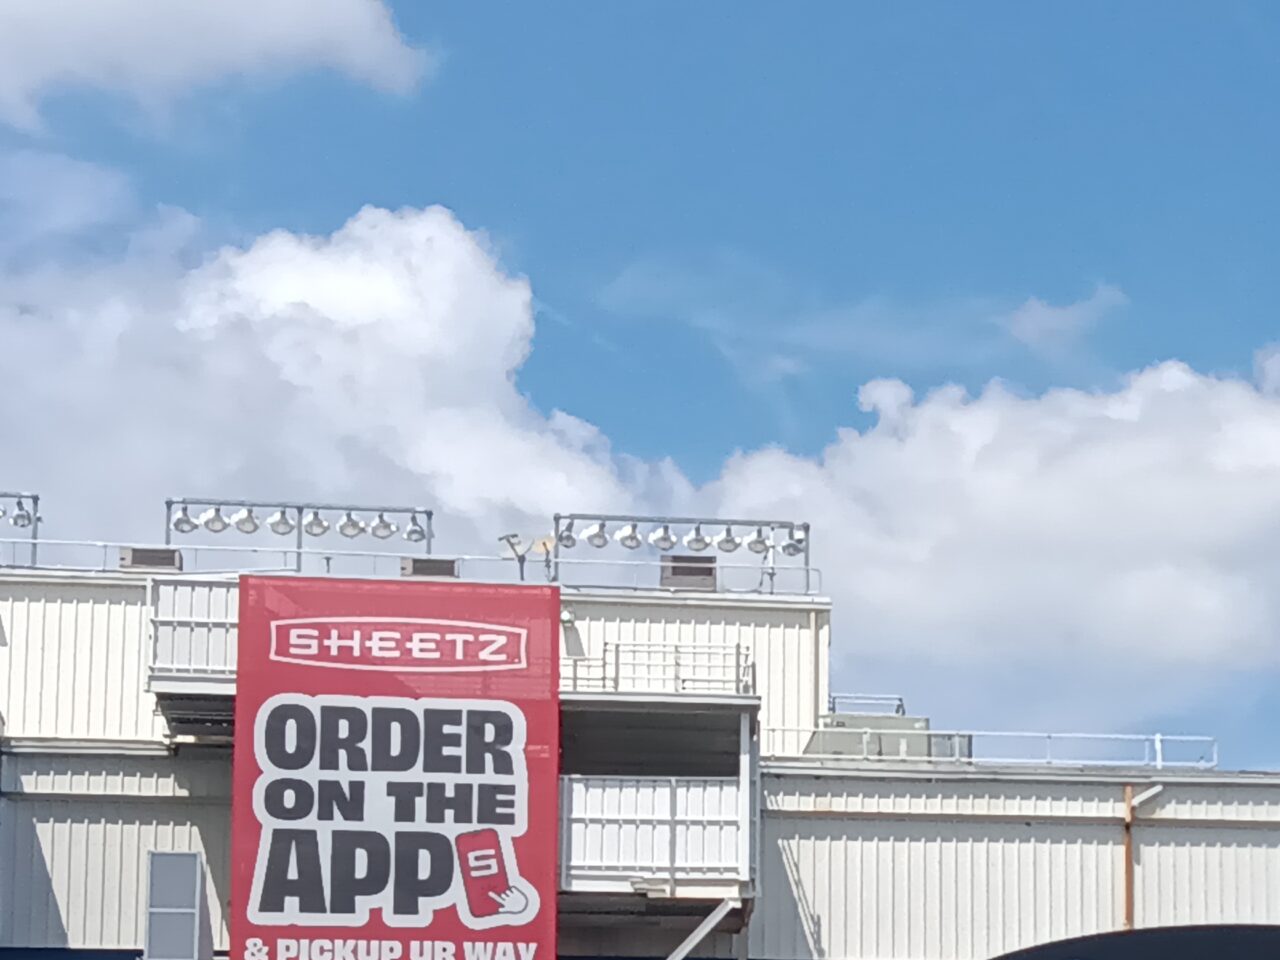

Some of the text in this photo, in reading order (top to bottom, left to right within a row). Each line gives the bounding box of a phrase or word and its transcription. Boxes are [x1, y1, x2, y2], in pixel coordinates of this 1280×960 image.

[289, 627, 508, 661] SHEETZ
[264, 703, 515, 775] ORDER
[263, 778, 516, 825] ON THE
[258, 828, 455, 915] APP
